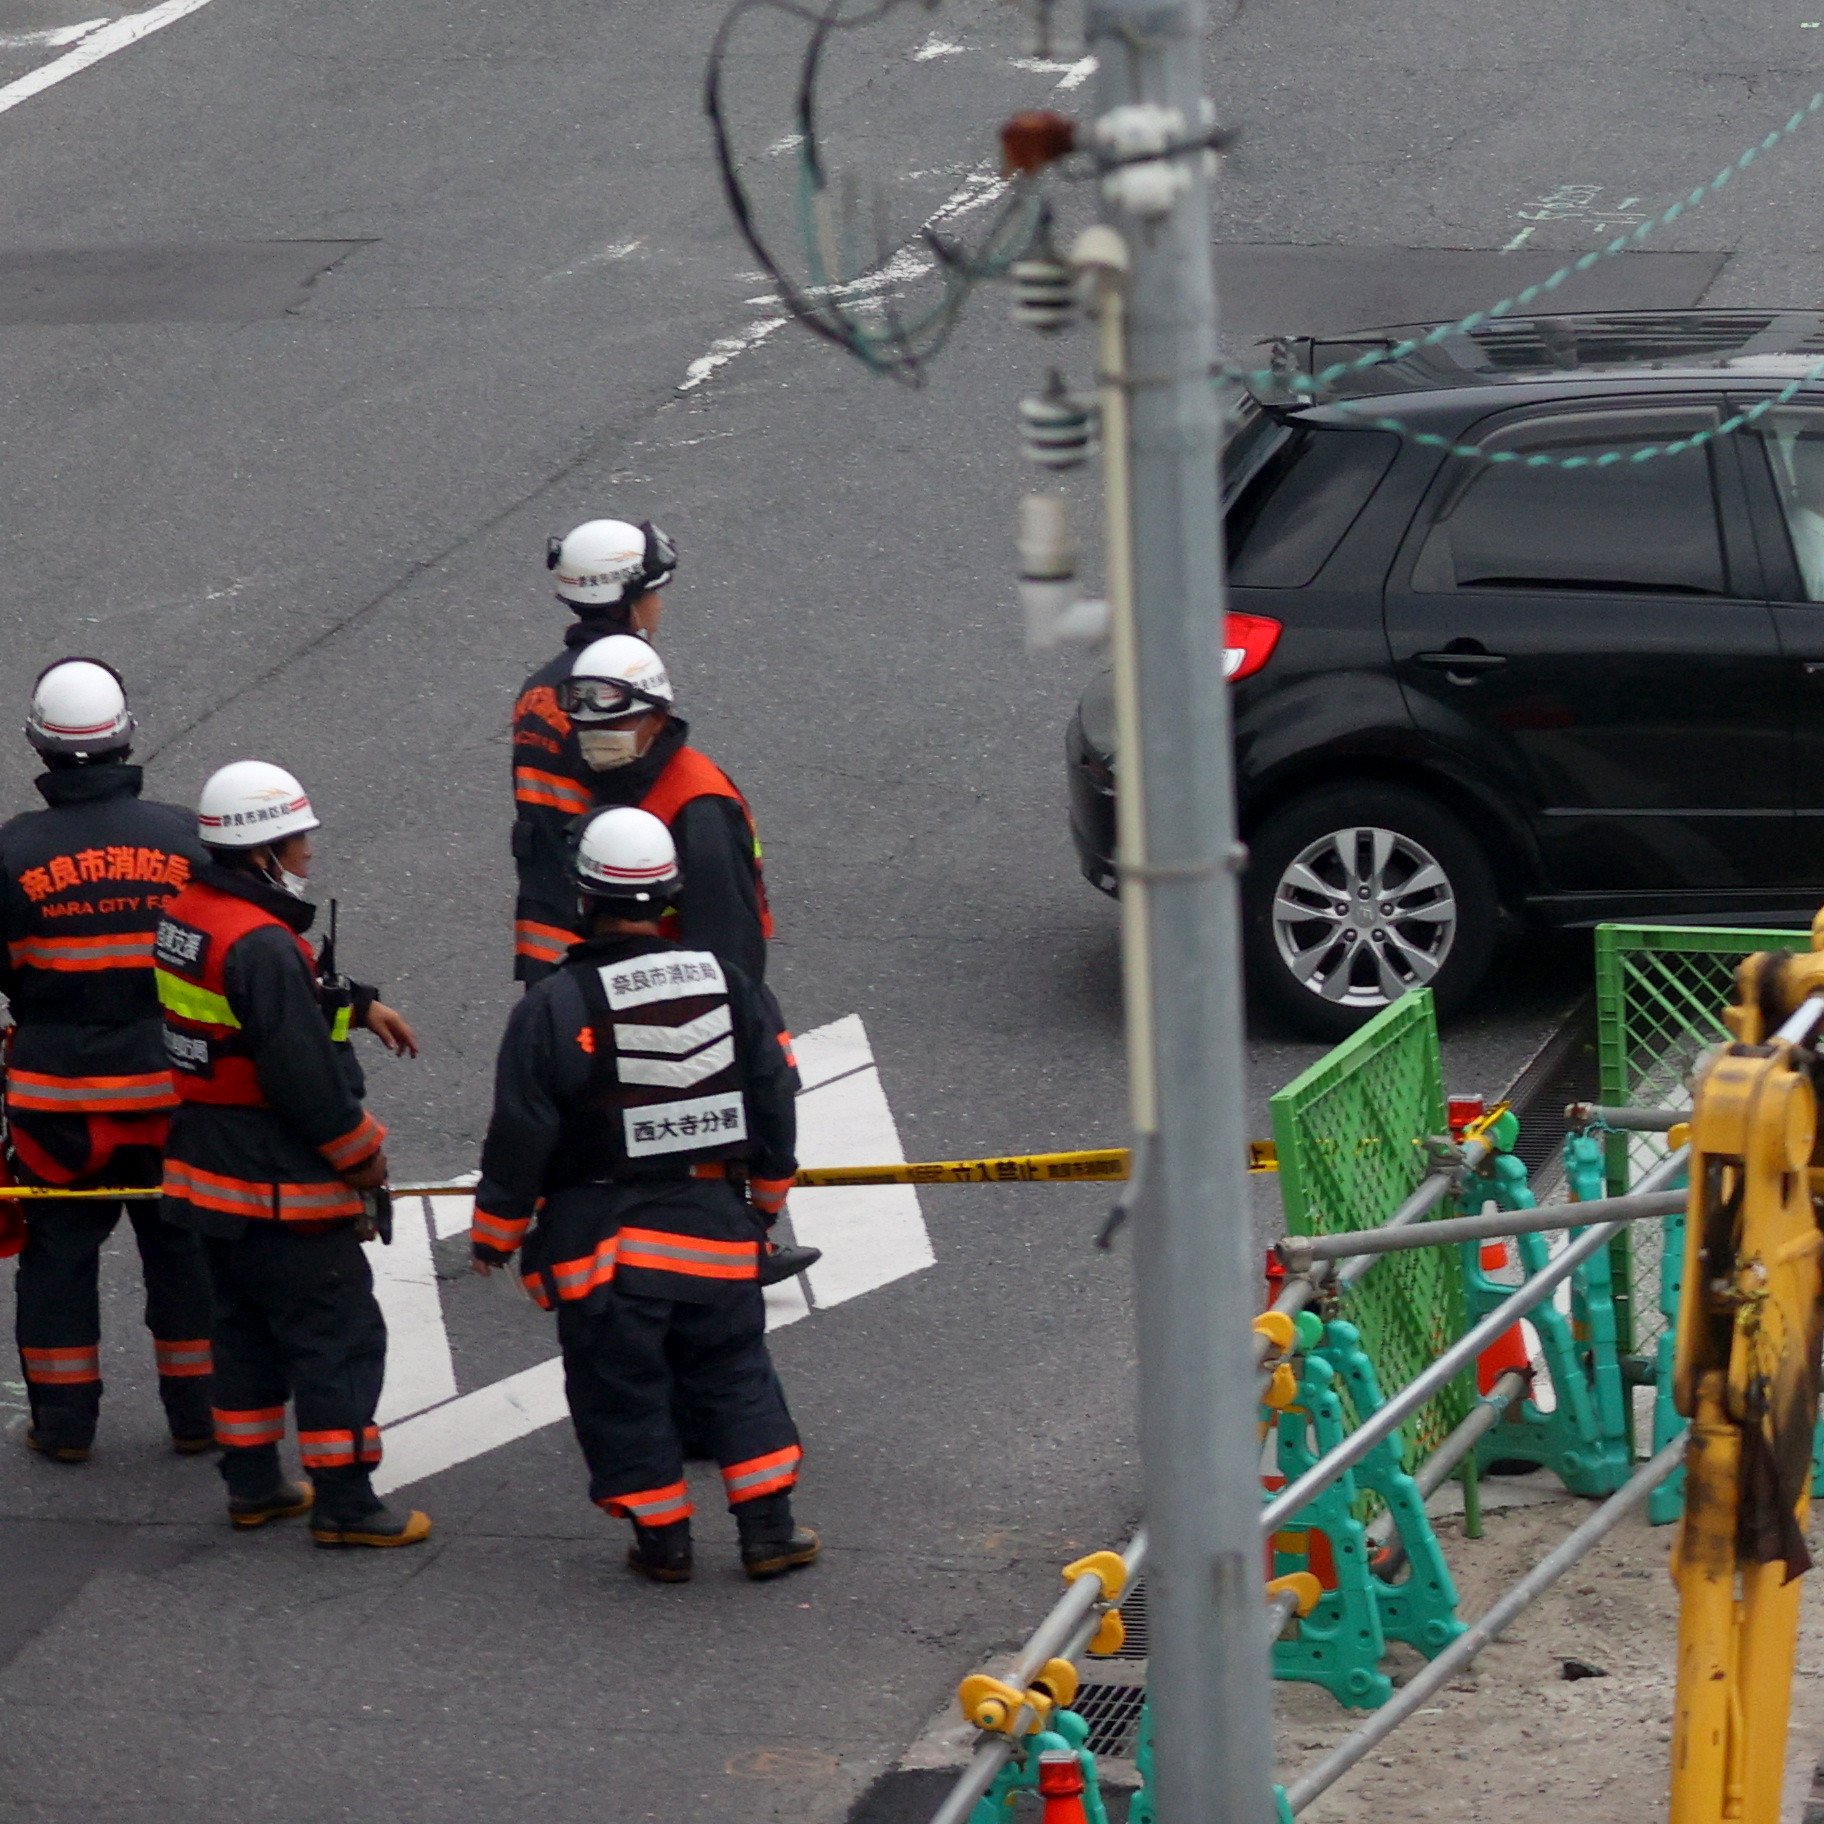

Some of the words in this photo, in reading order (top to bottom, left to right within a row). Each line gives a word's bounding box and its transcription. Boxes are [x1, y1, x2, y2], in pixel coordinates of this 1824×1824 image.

[19, 845, 192, 902] 奈良市消防局
[42, 900, 94, 918] NARA
[99, 897, 140, 914] CITY
[612, 962, 717, 995] 奈良市消防局
[633, 1107, 739, 1143] 西大寺分署
